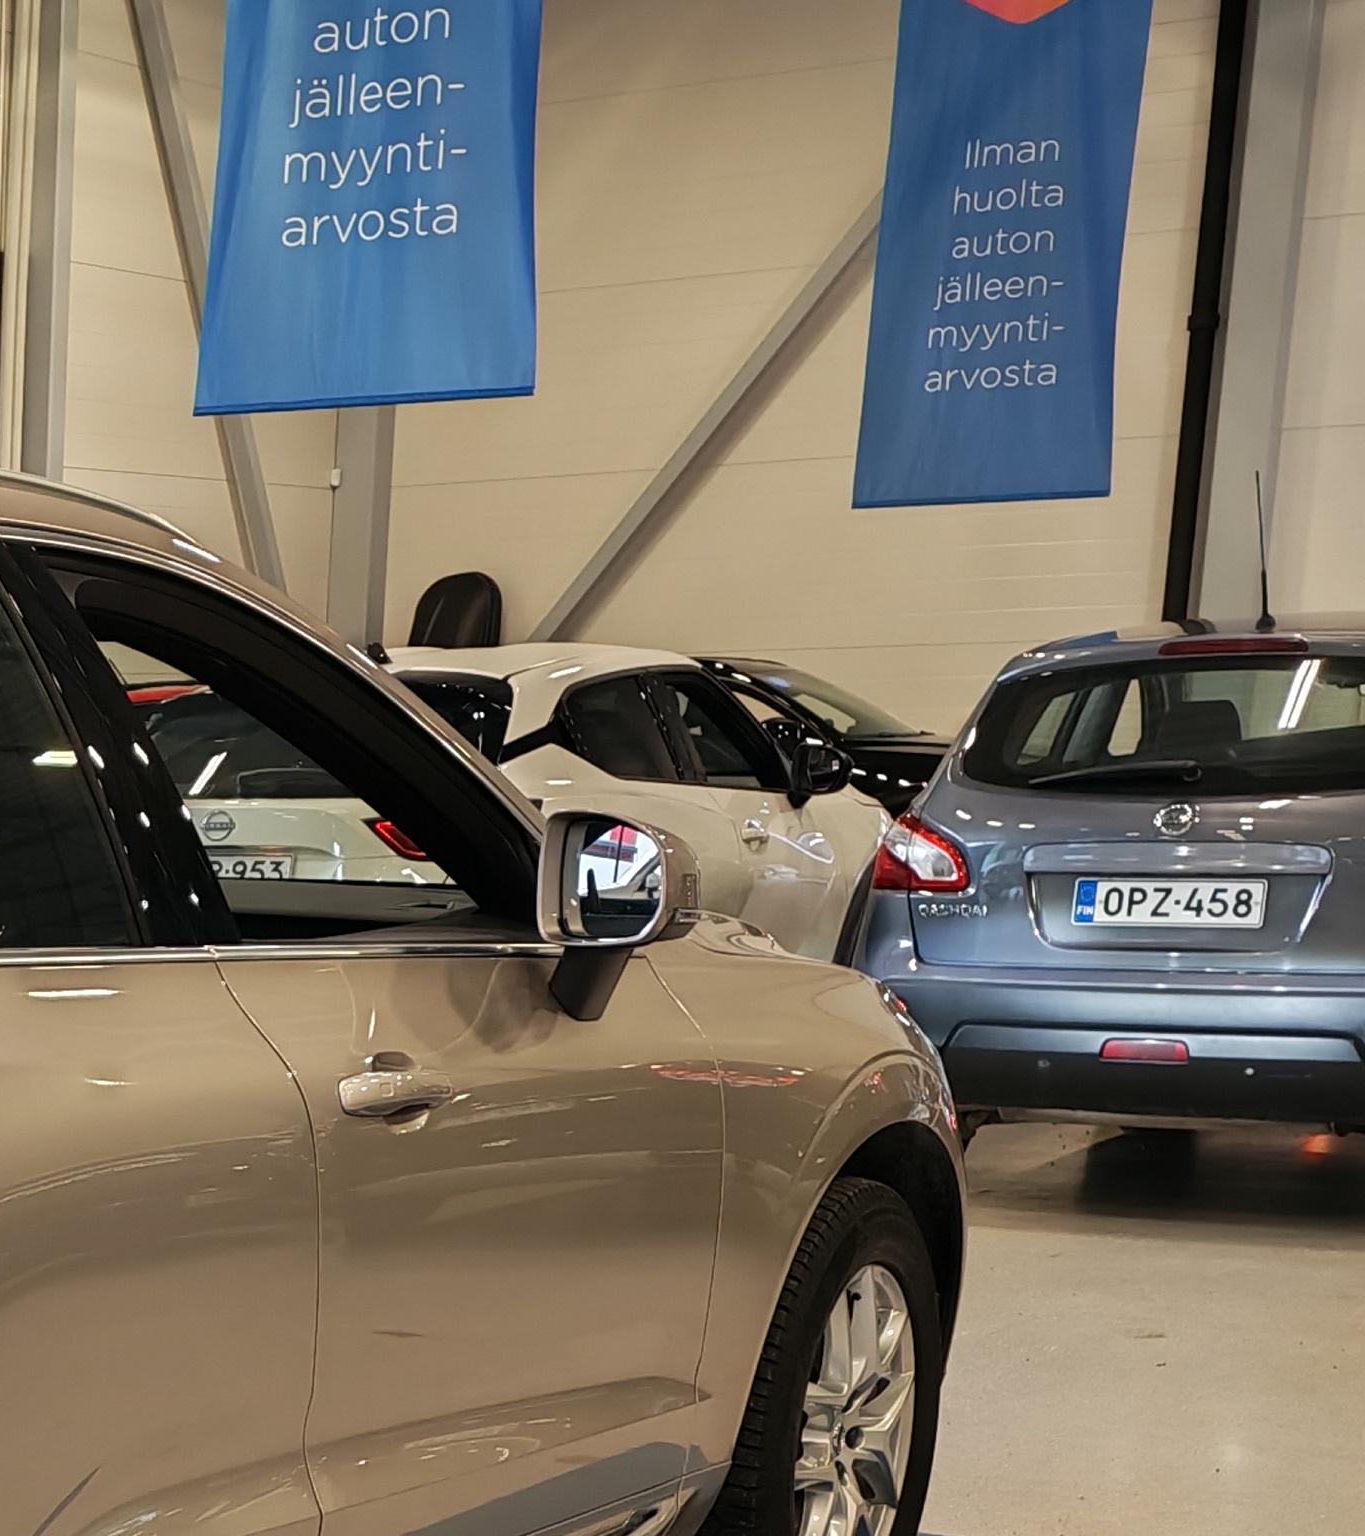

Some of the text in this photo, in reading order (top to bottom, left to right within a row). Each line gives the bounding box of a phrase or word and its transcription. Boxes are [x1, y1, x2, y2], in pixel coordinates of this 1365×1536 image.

[313, 7, 450, 53] auton
[288, 72, 465, 128] jälleen-
[283, 128, 467, 189] myynti-
[965, 138, 1060, 170] Ilman
[953, 178, 1065, 216] huolta
[281, 197, 459, 247] arvosta
[951, 228, 1055, 260] auton
[933, 271, 1065, 311] jälleen-
[927, 312, 1066, 352] myynti-
[924, 359, 1058, 393] arvosta
[1076, 886, 1254, 919] FIN OPZ-458
